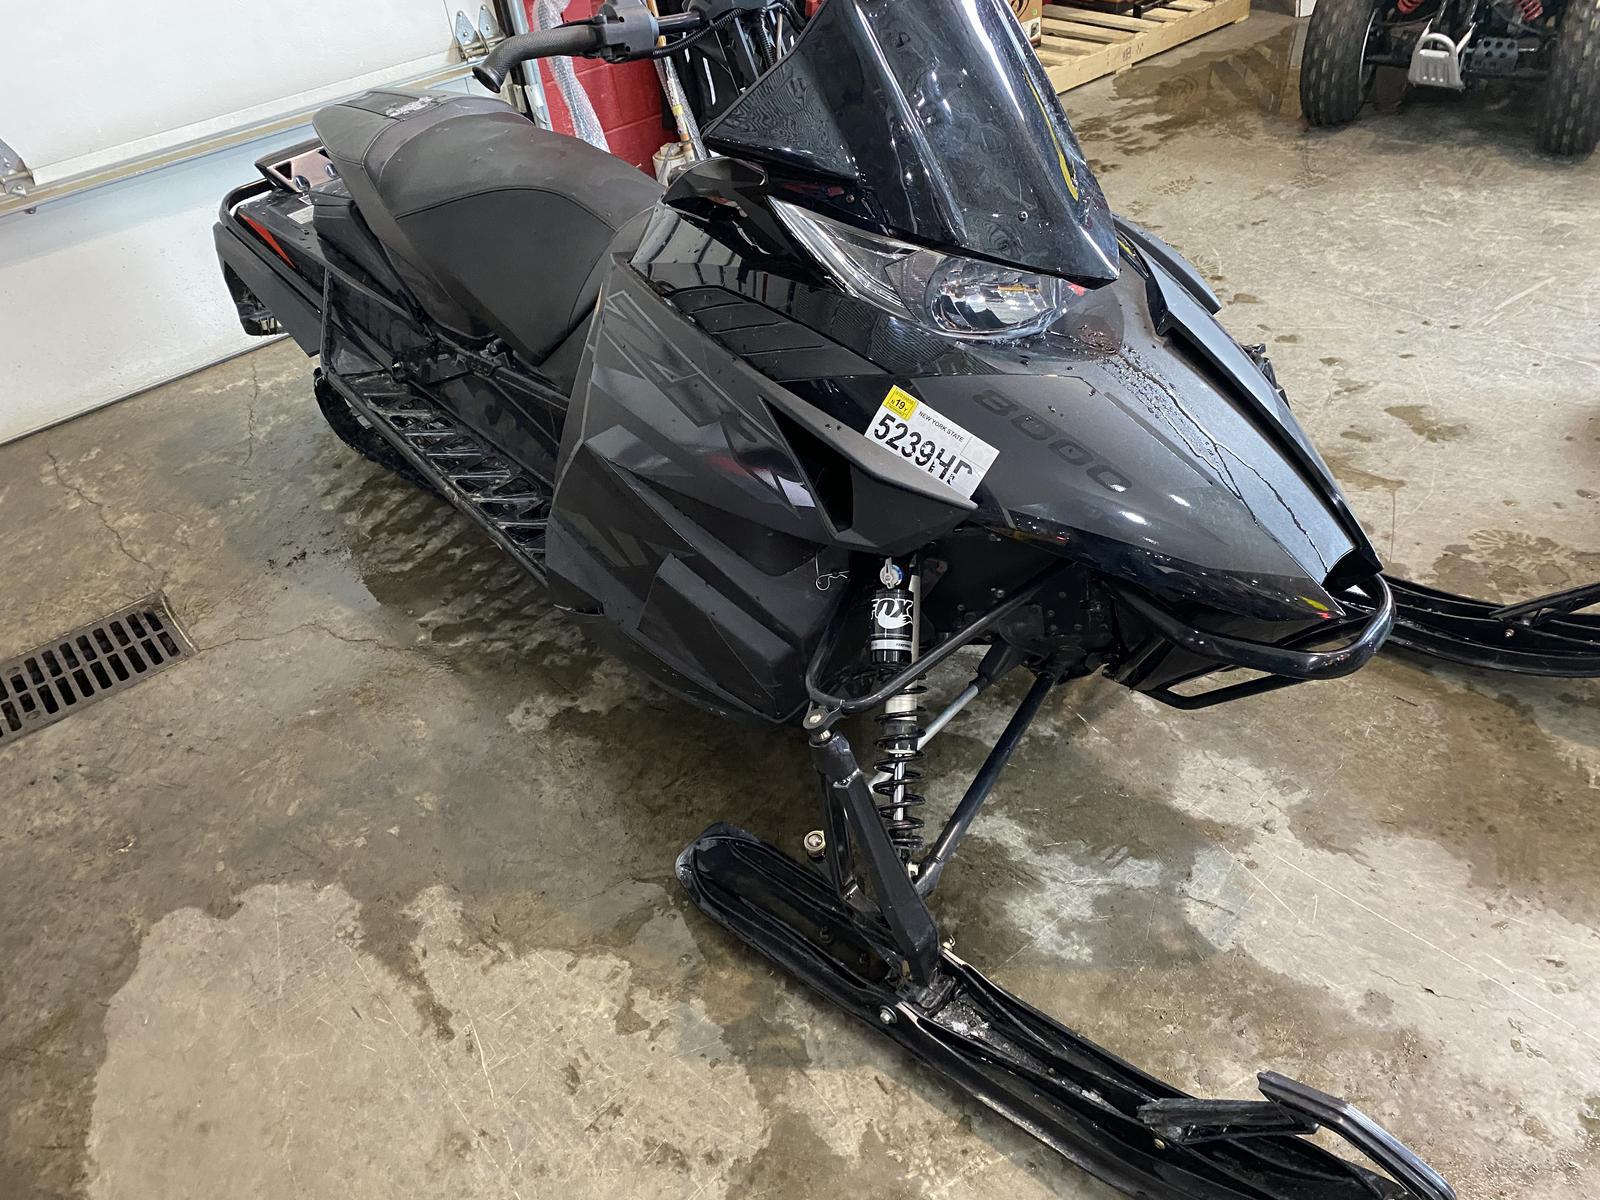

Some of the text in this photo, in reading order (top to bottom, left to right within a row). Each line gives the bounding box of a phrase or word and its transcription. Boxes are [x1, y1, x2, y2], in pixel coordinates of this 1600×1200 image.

[895, 399, 905, 410] 19
[918, 411, 965, 442] NEW YORK STATE
[972, 389, 1132, 492] 8000
[871, 598, 914, 627] FOX
